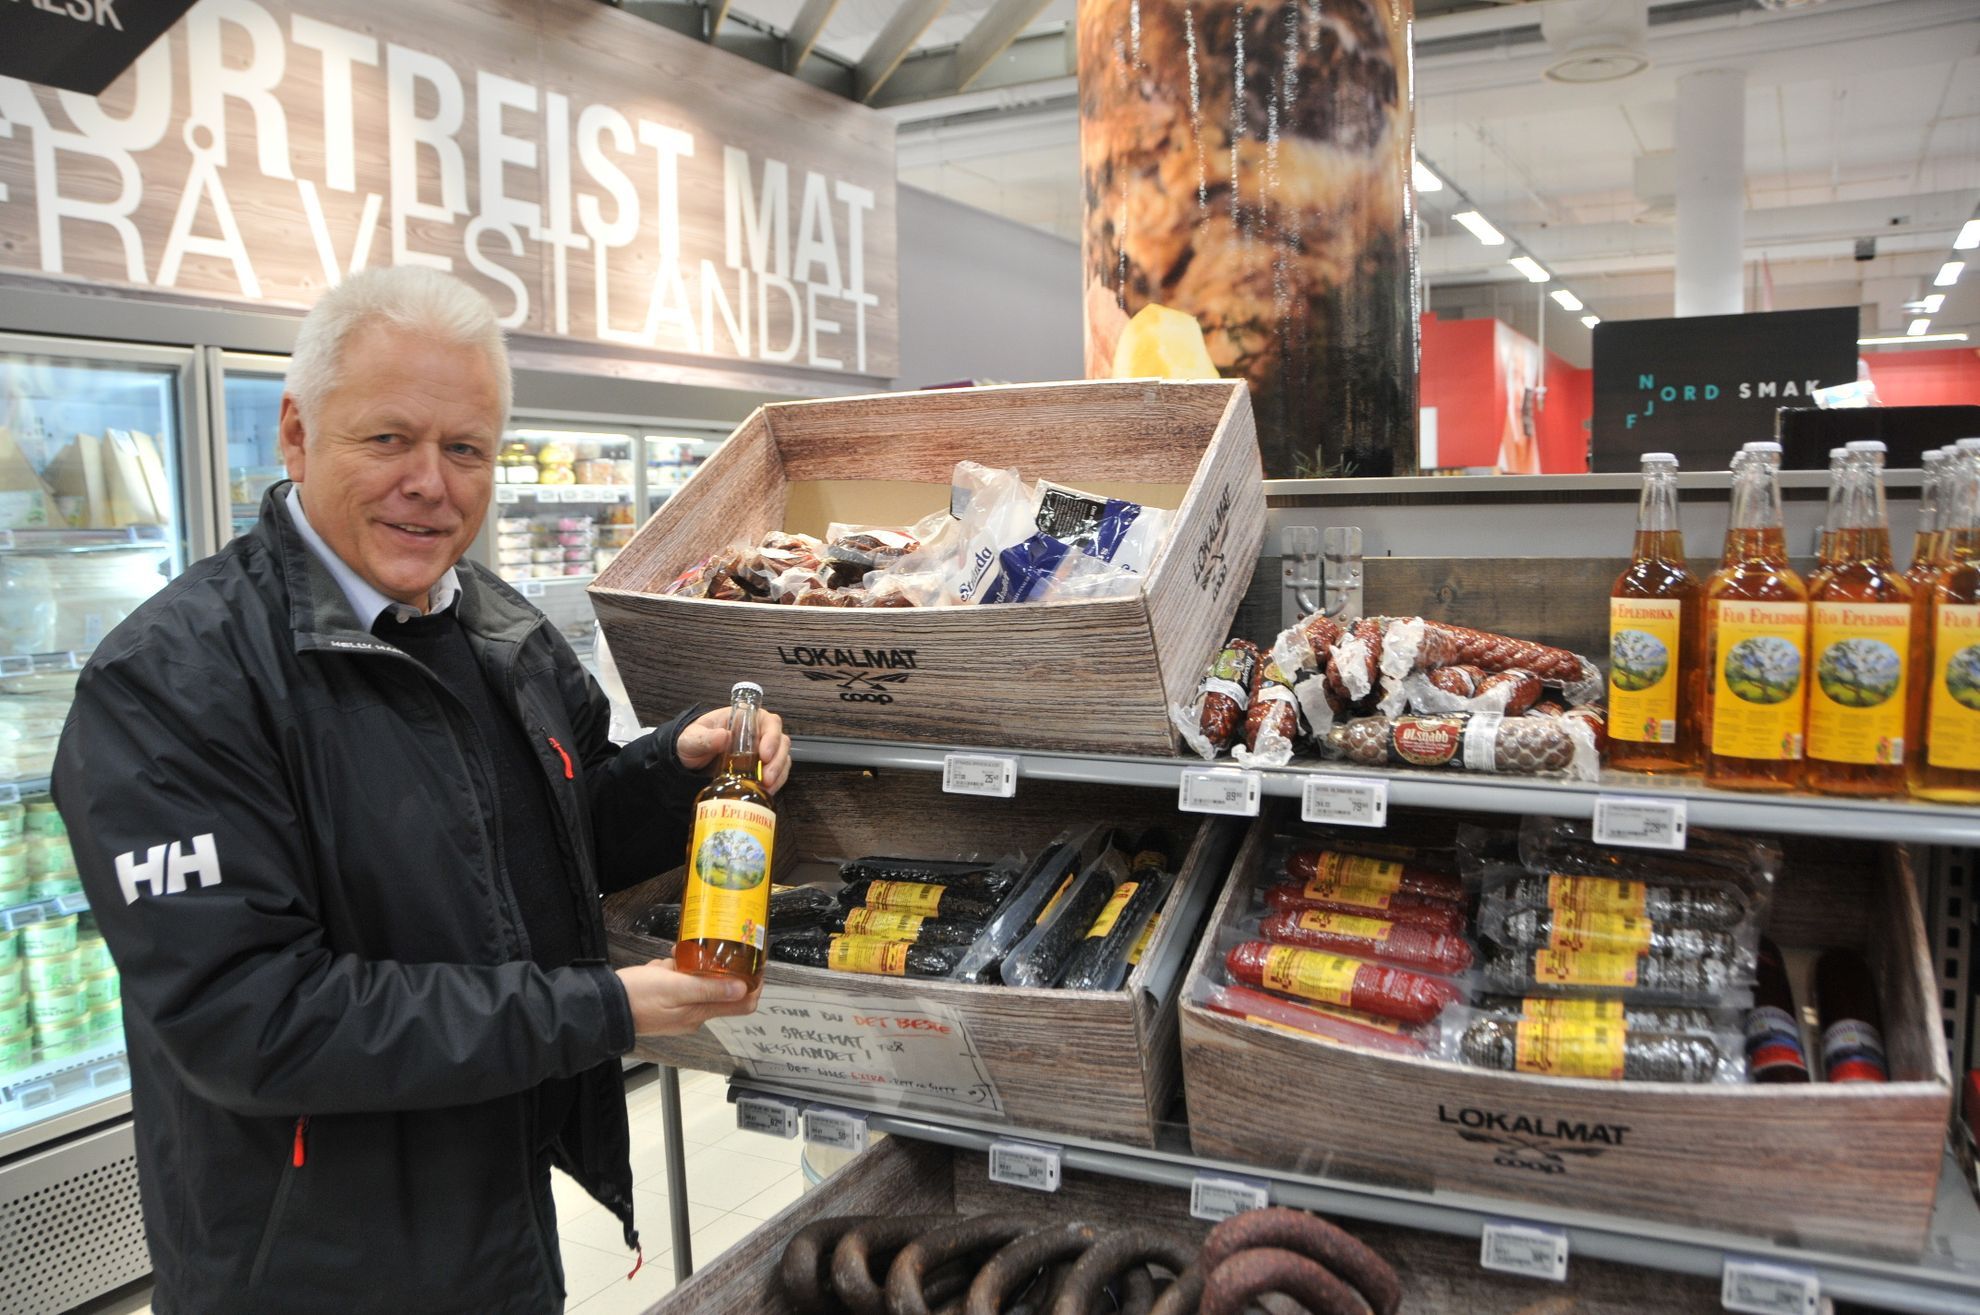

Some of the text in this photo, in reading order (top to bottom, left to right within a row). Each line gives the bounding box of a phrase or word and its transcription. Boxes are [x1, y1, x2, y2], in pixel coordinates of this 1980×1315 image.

[0, 114, 880, 372] RÅ VESTLANDET
[723, 145, 874, 304] MAT
[1738, 379, 1822, 399] SMAK
[777, 646, 917, 669] LOKALMAT
[839, 692, 894, 705] coop
[114, 833, 223, 905] HH
[1438, 1104, 1632, 1146] LOKALMAT
